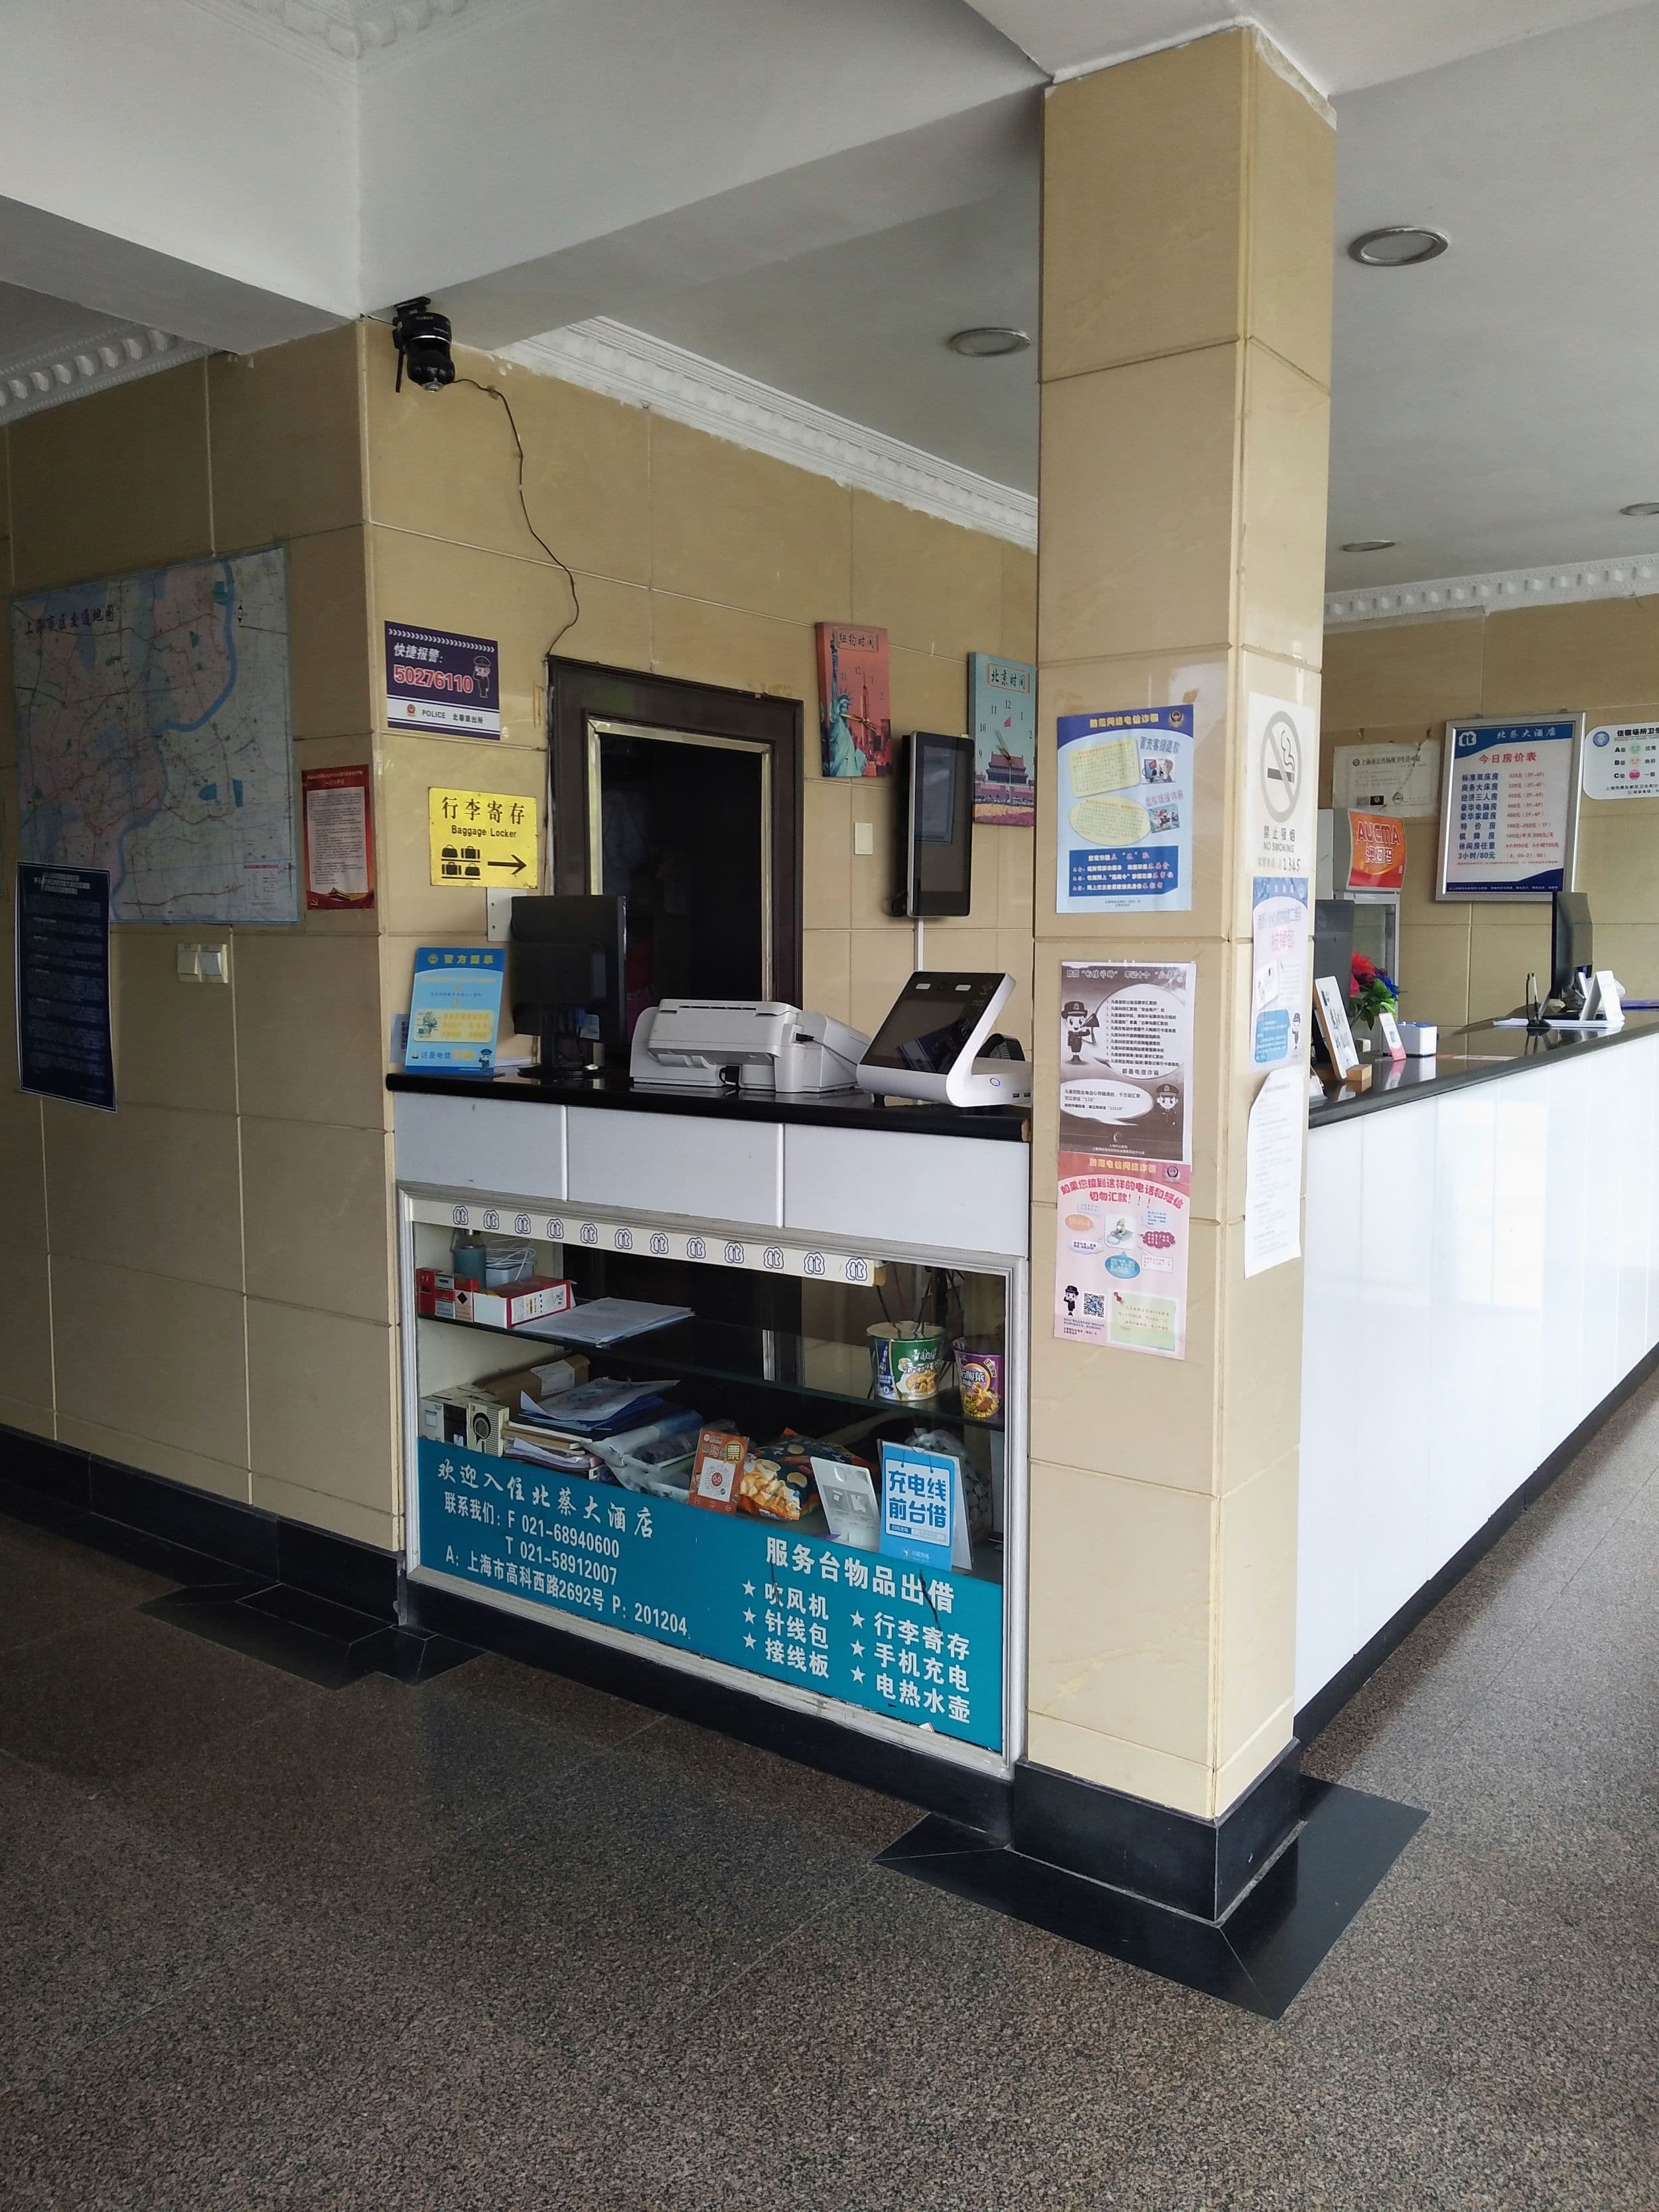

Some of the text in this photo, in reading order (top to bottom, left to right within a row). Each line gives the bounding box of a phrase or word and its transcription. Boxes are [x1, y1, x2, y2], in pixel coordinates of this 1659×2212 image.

[394, 664, 474, 694] 50276110
[991, 668, 1025, 690] 北京时间
[422, 709, 446, 719] POLICE
[991, 705, 997, 714] 11
[1005, 700, 1011, 709] 12
[979, 723, 986, 732] 10
[1496, 727, 1556, 739] 北蔡大酒店
[1479, 751, 1537, 763] 今日房价表
[1462, 773, 1498, 782] 标准双床房
[1462, 783, 1498, 792] 商务大床房
[441, 796, 525, 824] 行李寄存
[1461, 793, 1498, 802] 经济三人房
[451, 825, 517, 838] Baggage Locker
[1263, 826, 1295, 842] 禁止吸烟
[1263, 841, 1295, 853] NO SMOKING
[1279, 857, 1301, 871] 12345
[1089, 1158, 1156, 1173] 防范电信网络诈骗
[1060, 1178, 1185, 1209] 如果您接到这样的电话和短信
[437, 1458, 654, 1538] 欢迎入住北蔡大酒店
[889, 1470, 946, 1502] 充电线
[445, 1491, 620, 1558] 联系我们： F 021-68940600
[889, 1497, 946, 1528] 前台借
[506, 1536, 618, 1585] T 021-58912007
[766, 1536, 954, 1613] 服务台物品出借
[467, 1550, 605, 1611] 上海市高科西路2692号
[635, 1603, 687, 1637] 201204
[764, 1583, 830, 1621] 吹风机
[765, 1609, 829, 1649] 针线包
[874, 1612, 970, 1660] 行李寄存
[765, 1638, 830, 1679] 接线板
[875, 1643, 970, 1693] 手机充电
[876, 1672, 970, 1724] 电热水壶
